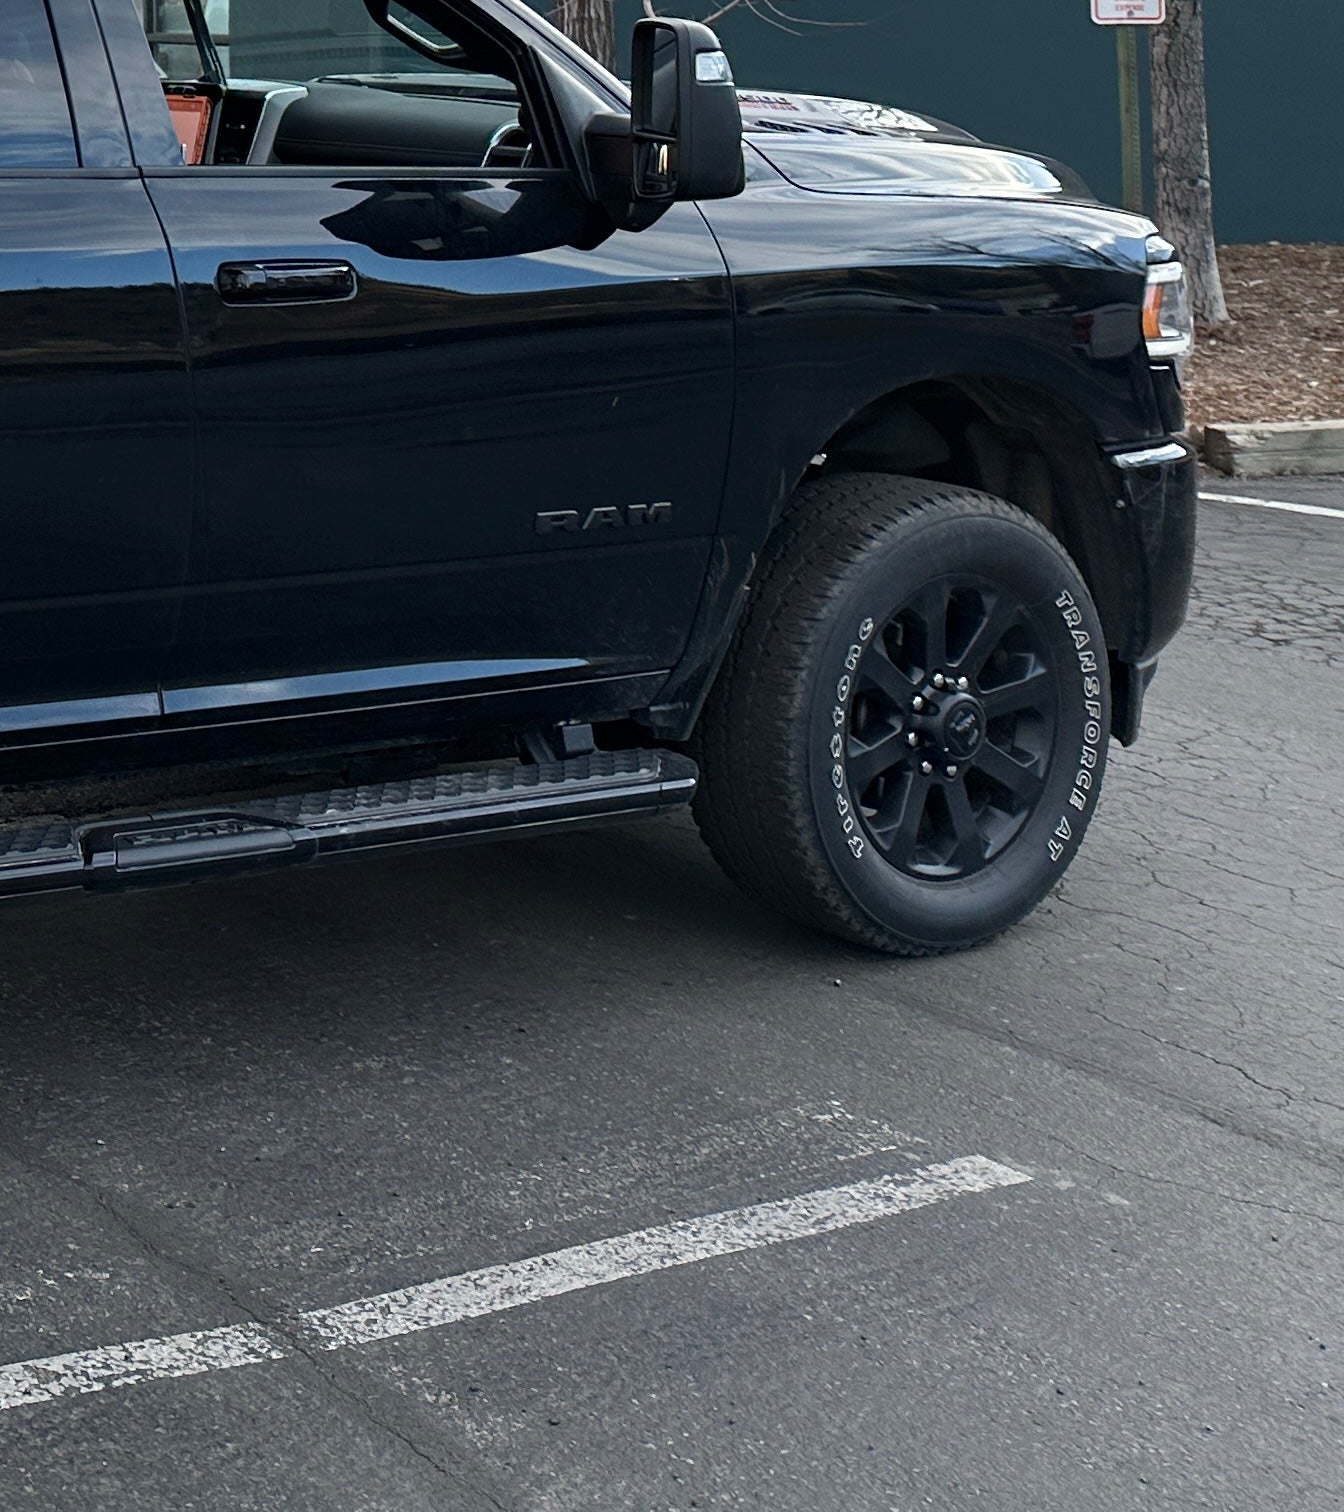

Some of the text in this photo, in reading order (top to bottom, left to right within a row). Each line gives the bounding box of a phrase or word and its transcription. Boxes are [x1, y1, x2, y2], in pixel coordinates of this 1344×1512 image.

[534, 501, 673, 536] RAM
[1047, 590, 1102, 862] TRANSFORCE AT
